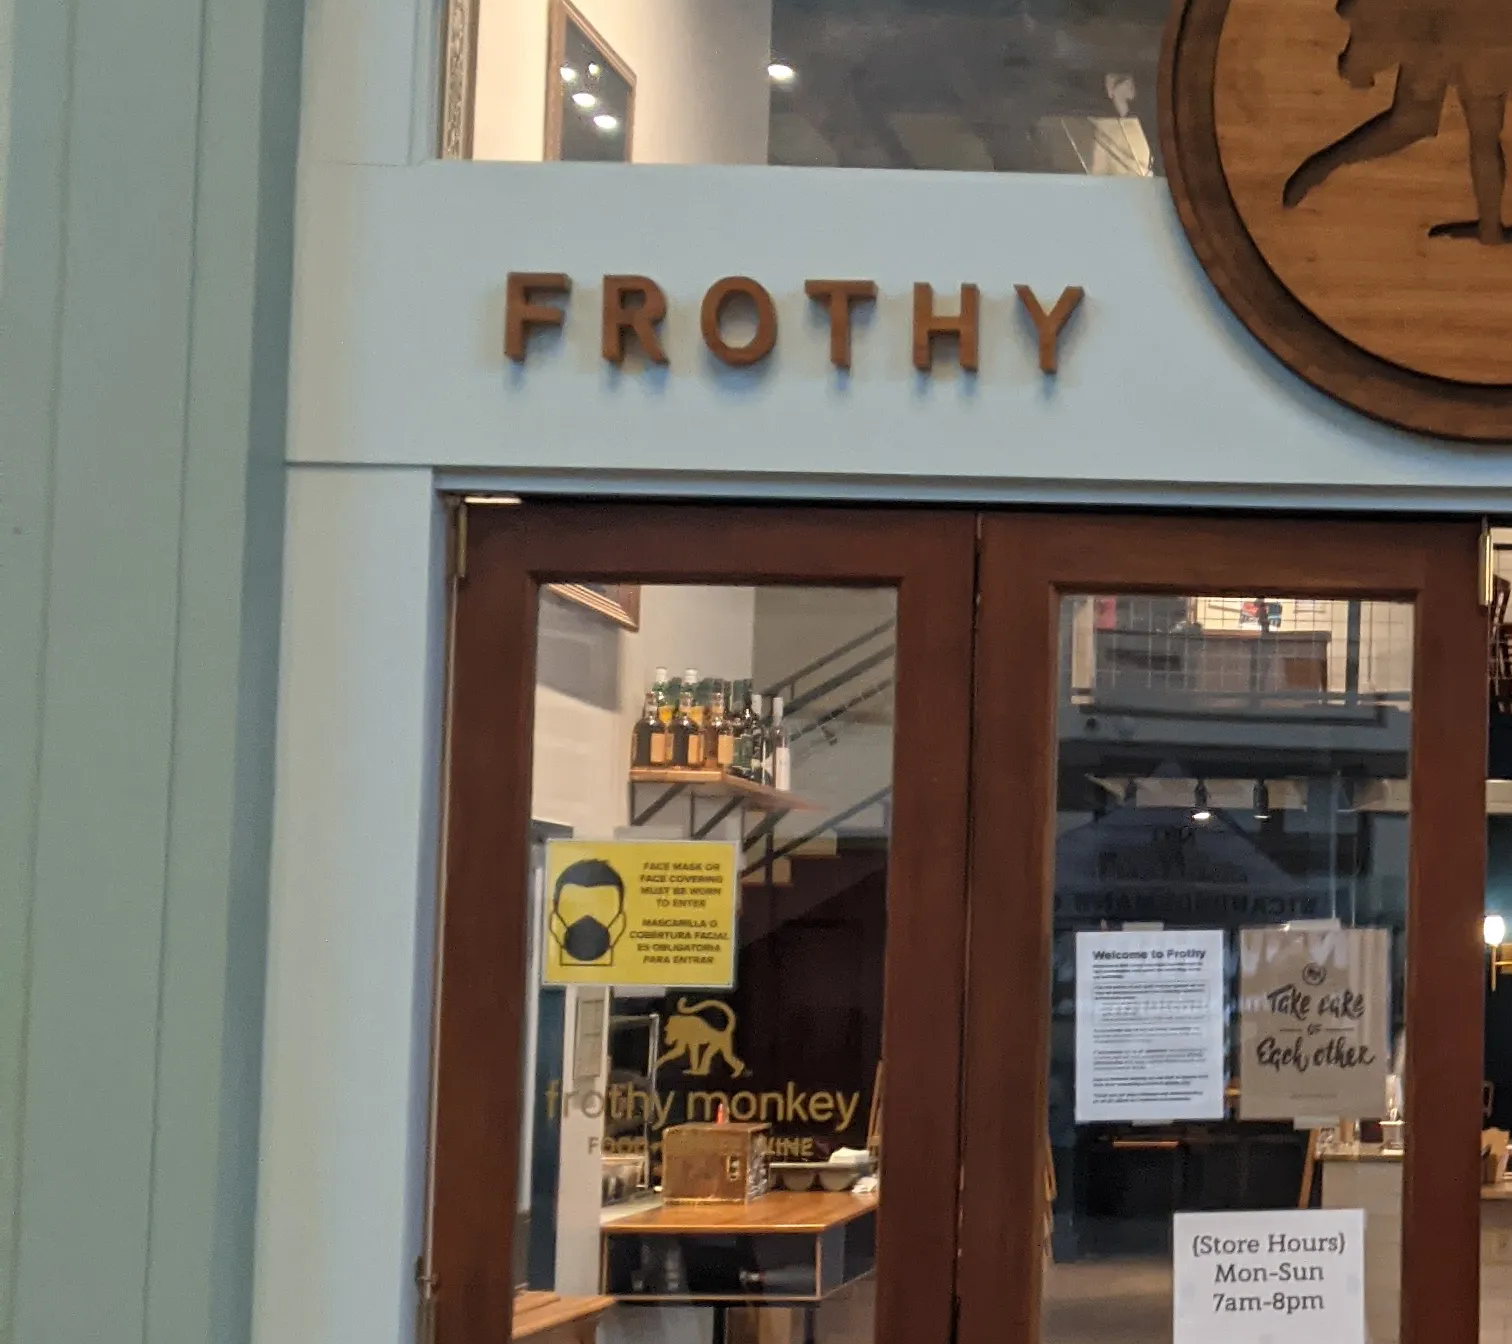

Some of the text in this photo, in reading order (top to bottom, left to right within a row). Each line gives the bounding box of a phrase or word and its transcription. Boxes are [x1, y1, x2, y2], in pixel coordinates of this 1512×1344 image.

[504, 271, 1086, 375] FROTHY
[643, 862, 720, 871] FACE MASK OR
[640, 874, 723, 884] FACE COVERING
[640, 886, 669, 895] MUST
[690, 887, 722, 896] WORN
[656, 898, 706, 908] TO ENTER
[1092, 948, 1206, 960] Welcome to Frothy
[545, 1080, 860, 1132] frothy monkey
[1192, 1232, 1346, 1258] (Store Hours)
[1214, 1262, 1324, 1284] Mon-Sun
[1212, 1292, 1324, 1315] 7am-8pm
